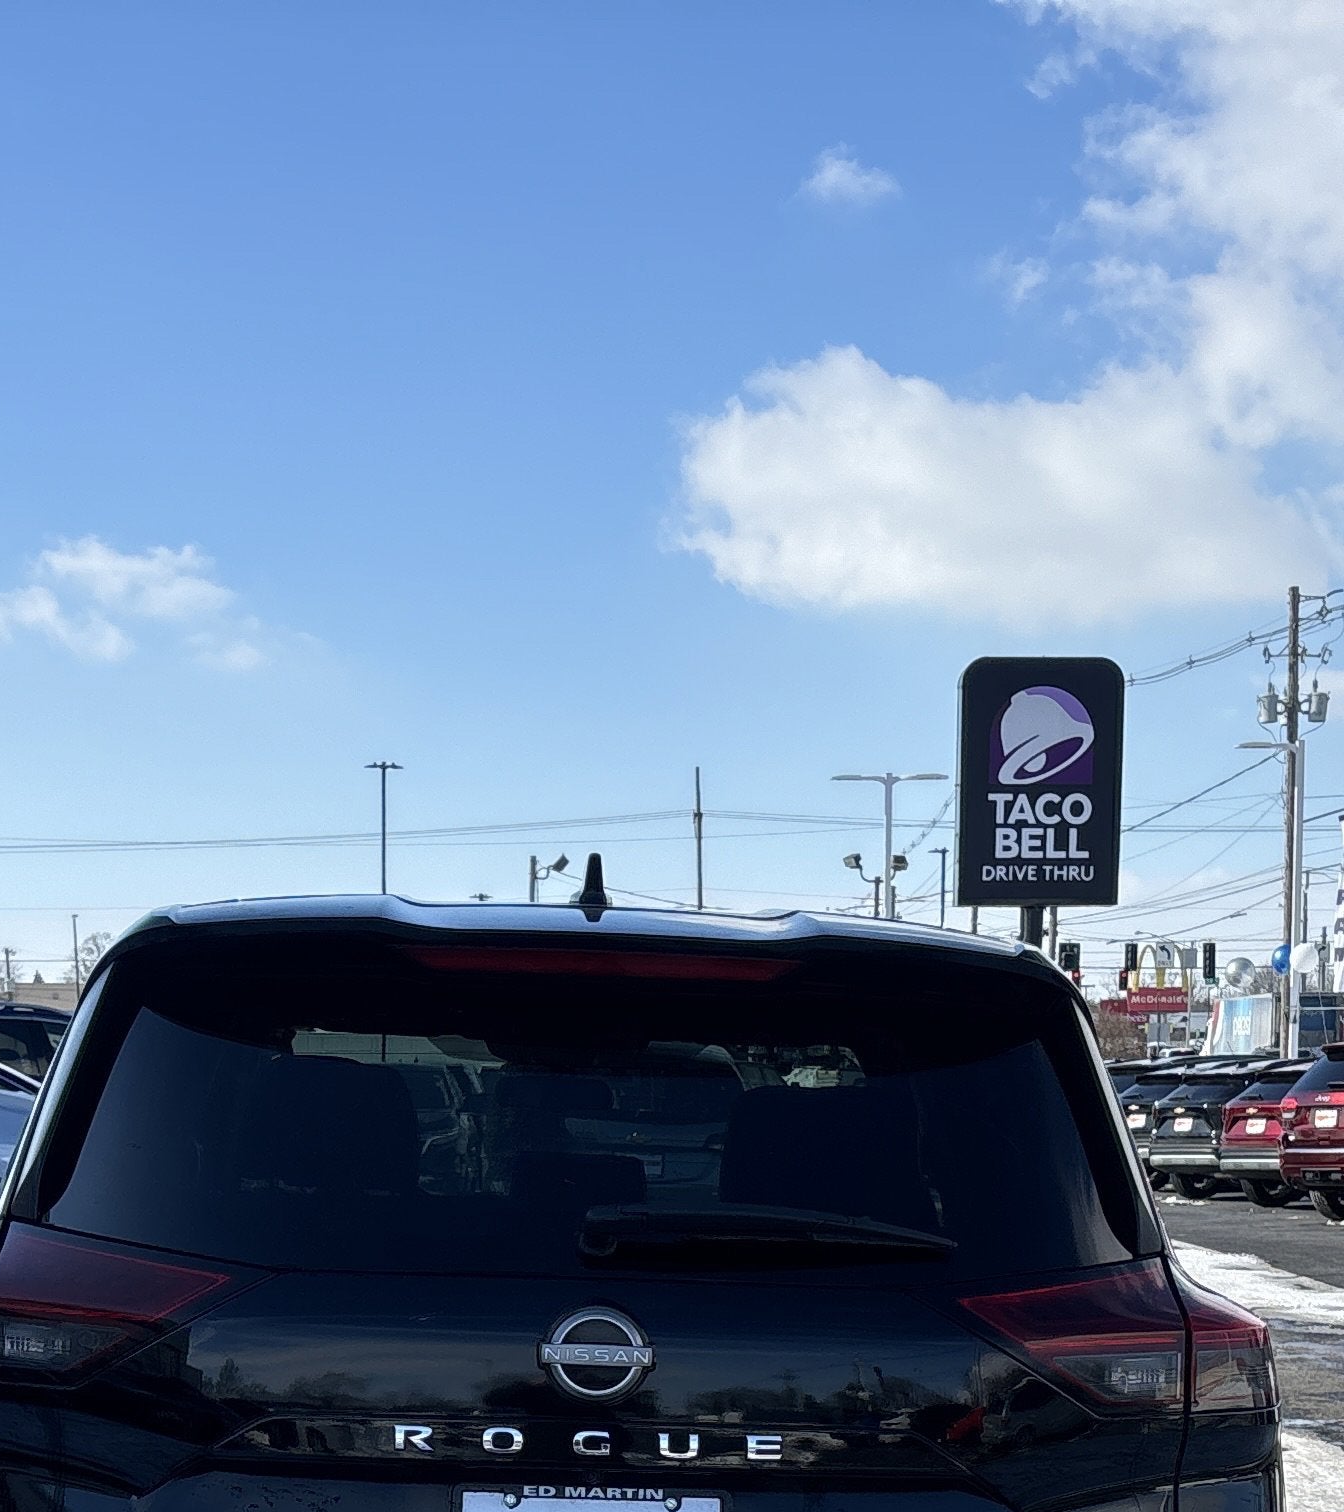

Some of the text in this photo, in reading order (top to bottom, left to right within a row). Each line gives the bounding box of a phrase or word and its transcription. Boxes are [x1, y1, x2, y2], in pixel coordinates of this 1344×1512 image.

[988, 792, 1093, 825] TACO
[994, 827, 1090, 859] BELL
[981, 865, 1095, 882] DRIVE THRU
[544, 1347, 649, 1364] NISSAN
[393, 1424, 784, 1461] ROGUE
[523, 1485, 664, 1500] ED MARTIN
